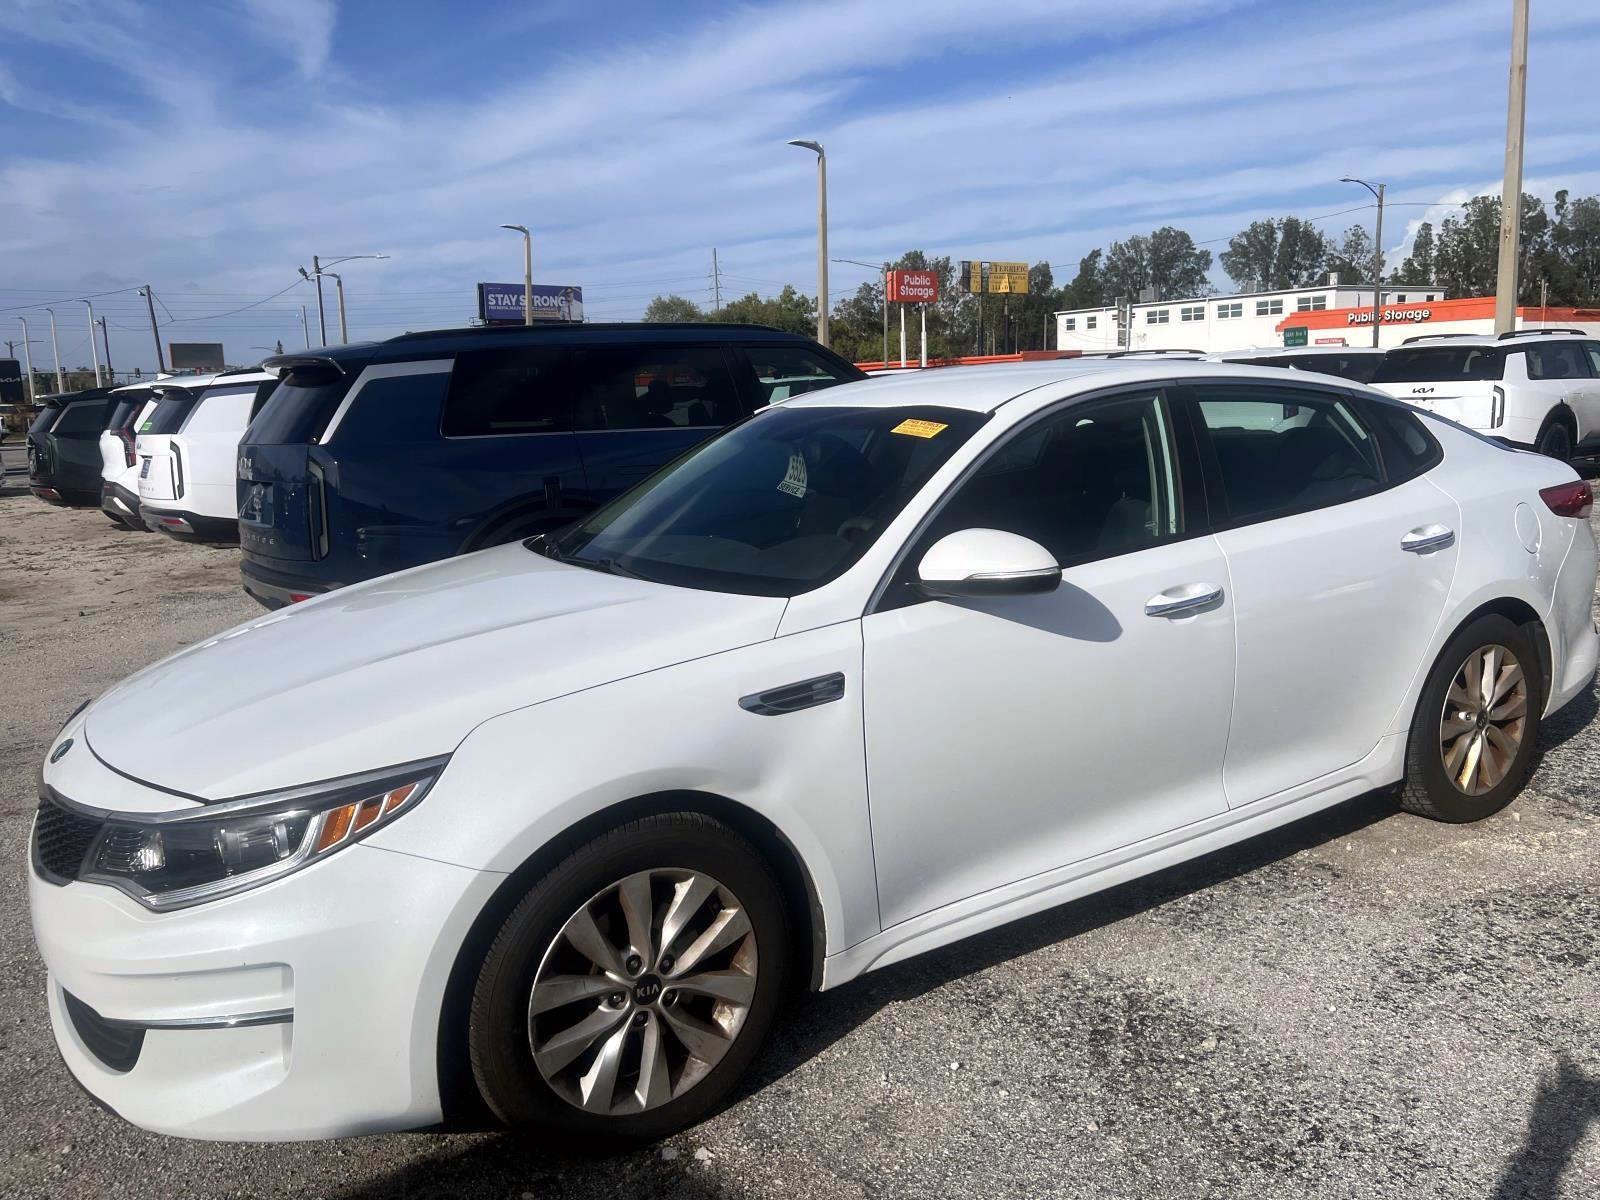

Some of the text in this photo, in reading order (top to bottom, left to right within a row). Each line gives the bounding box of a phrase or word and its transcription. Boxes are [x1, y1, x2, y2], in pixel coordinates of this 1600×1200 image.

[904, 275, 930, 286] Public
[900, 286, 934, 298] Storage
[488, 294, 566, 307] STAY SRONG
[1384, 309, 1430, 321] Storage
[778, 482, 801, 495] SERVICE
[636, 984, 659, 998] KIA
